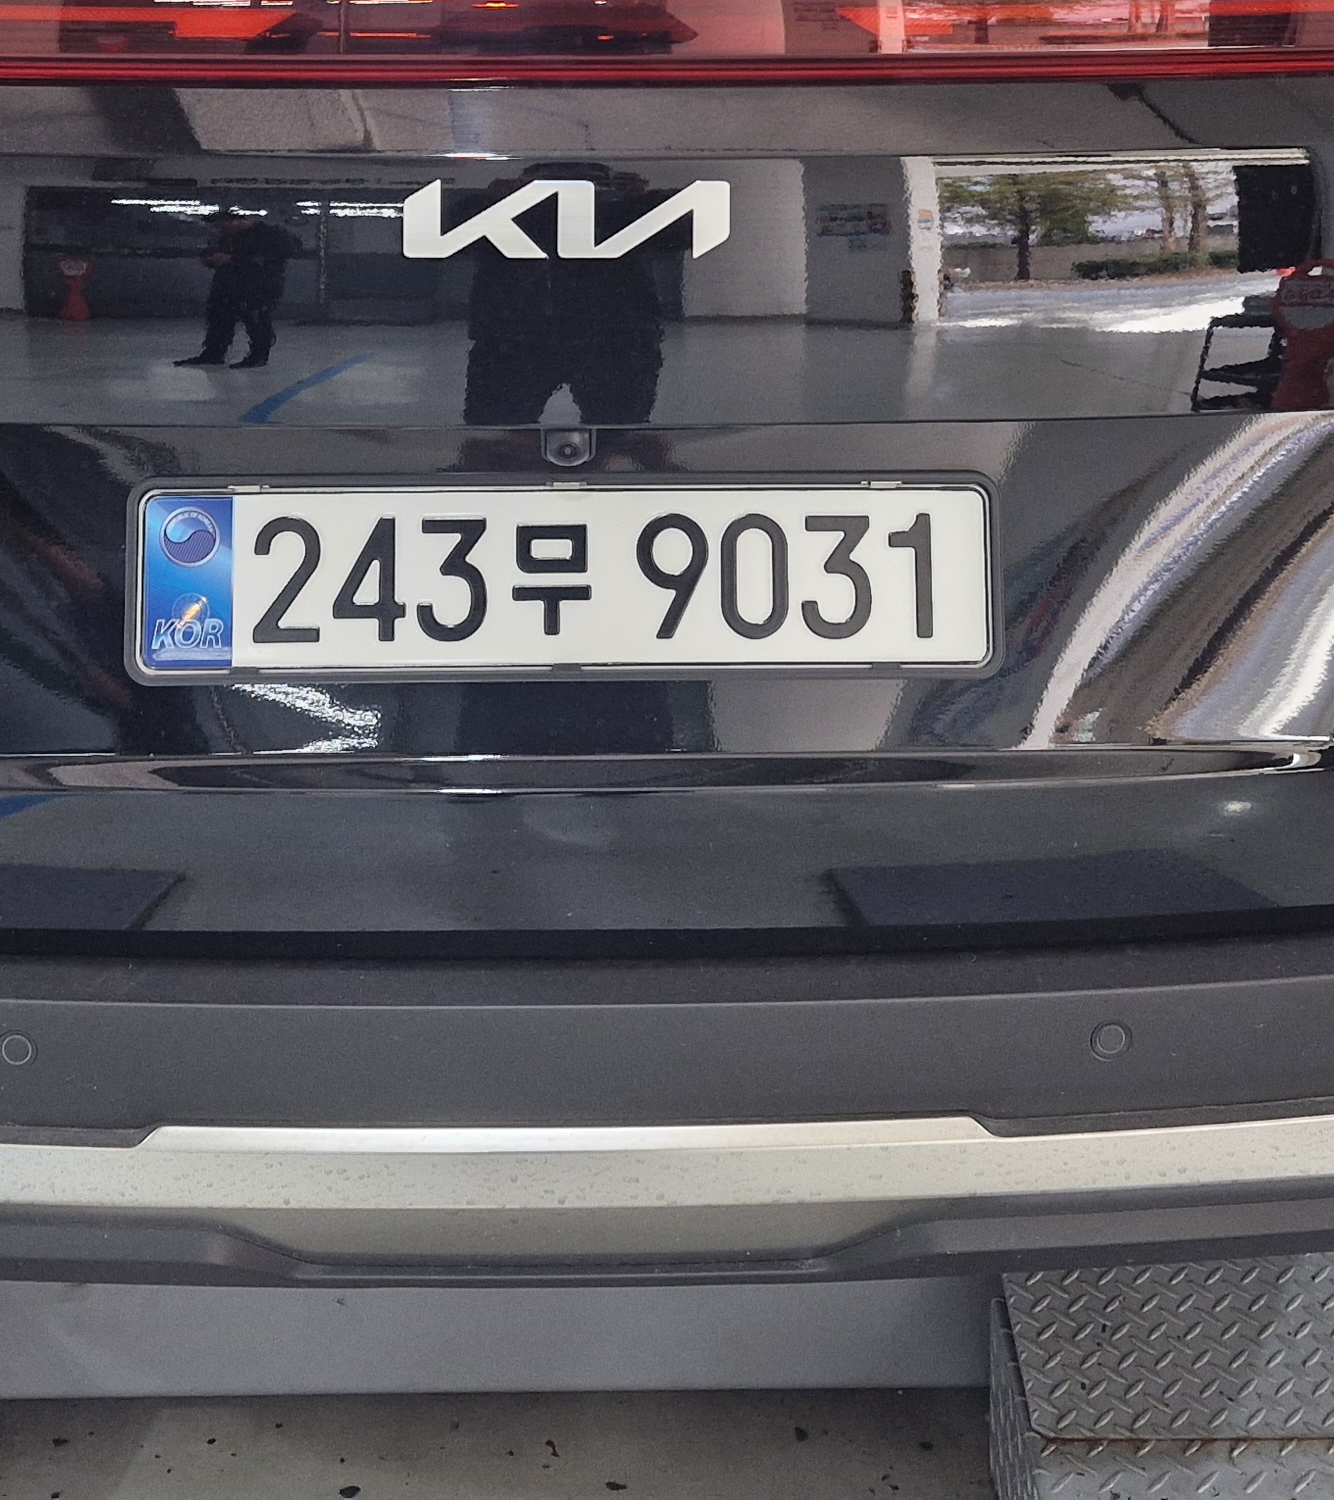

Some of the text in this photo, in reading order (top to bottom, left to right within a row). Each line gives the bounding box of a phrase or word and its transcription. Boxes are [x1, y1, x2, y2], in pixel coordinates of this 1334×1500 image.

[402, 179, 731, 259] KIA
[252, 512, 935, 644] 243무 9031
[151, 618, 224, 650] KOR
